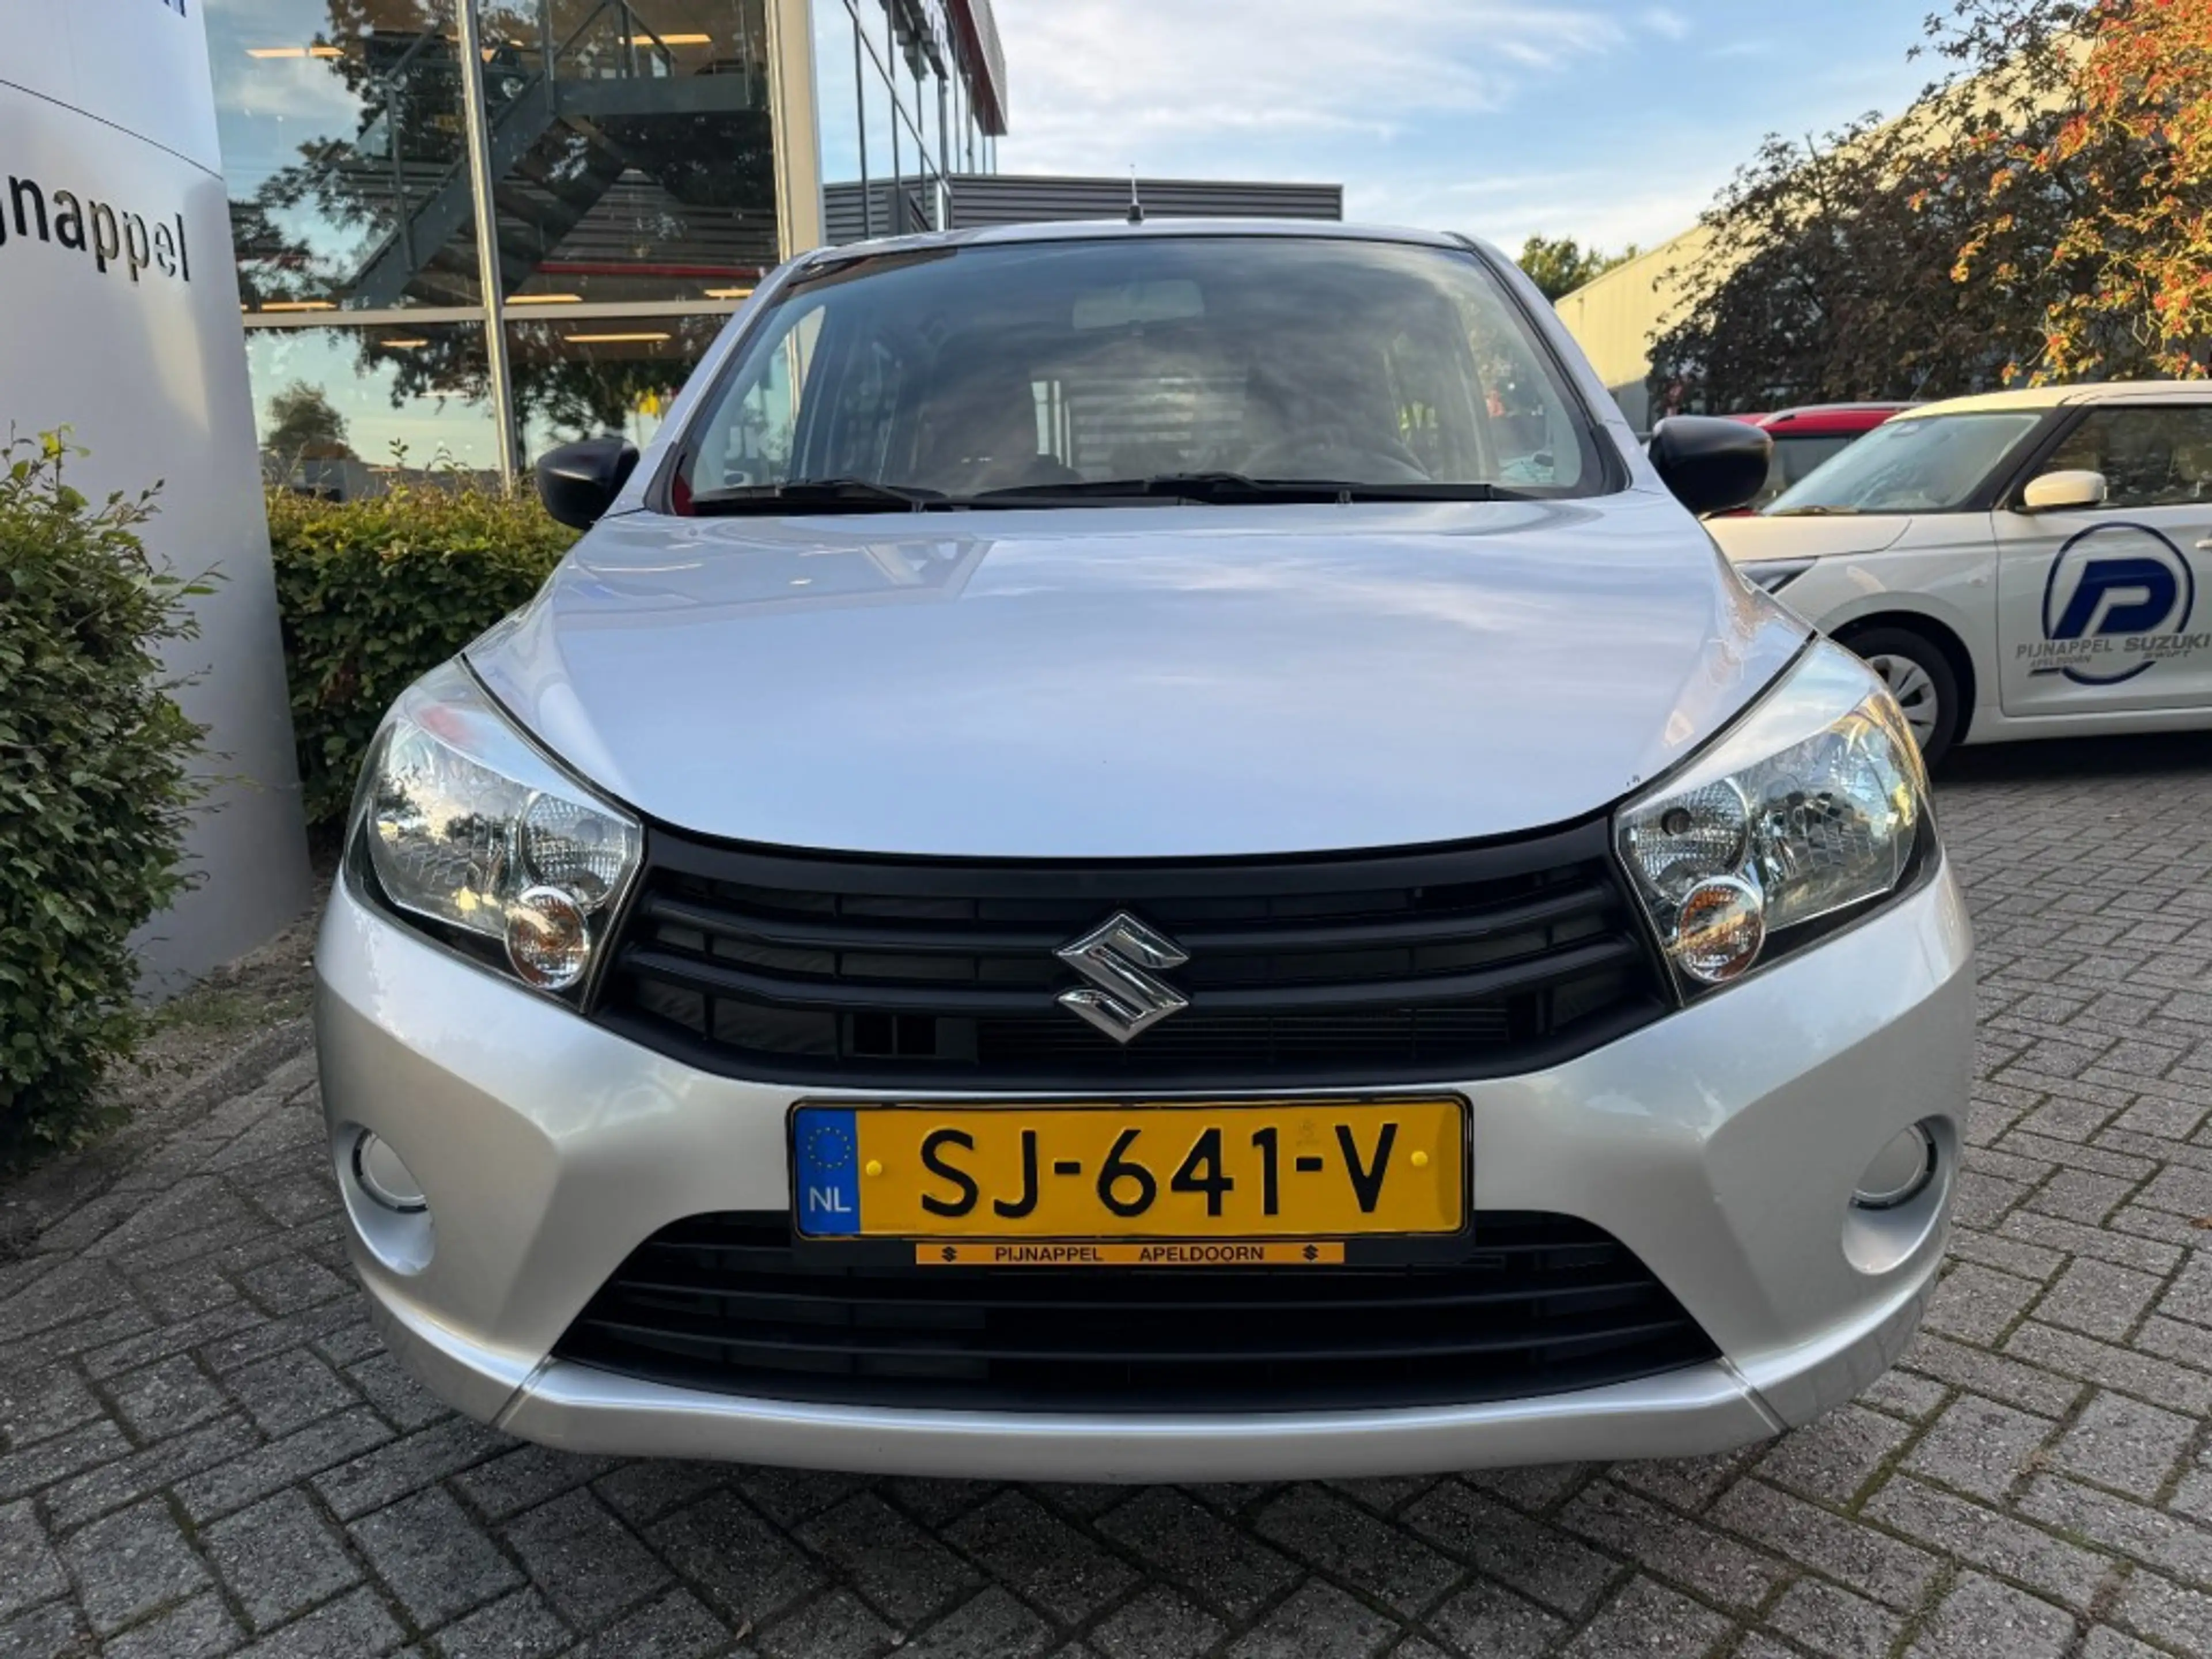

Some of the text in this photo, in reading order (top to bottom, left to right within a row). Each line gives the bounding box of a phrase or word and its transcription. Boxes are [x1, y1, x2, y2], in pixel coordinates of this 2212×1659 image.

[0, 175, 190, 283] nappel
[2016, 634, 2211, 658] PIJNAPPEL SUZUKI
[921, 1122, 1399, 1219] SJ-641-V
[809, 1187, 851, 1212] NL
[994, 1246, 1103, 1262] PIJNAPPEL
[1139, 1246, 1264, 1262] APELDOORN
